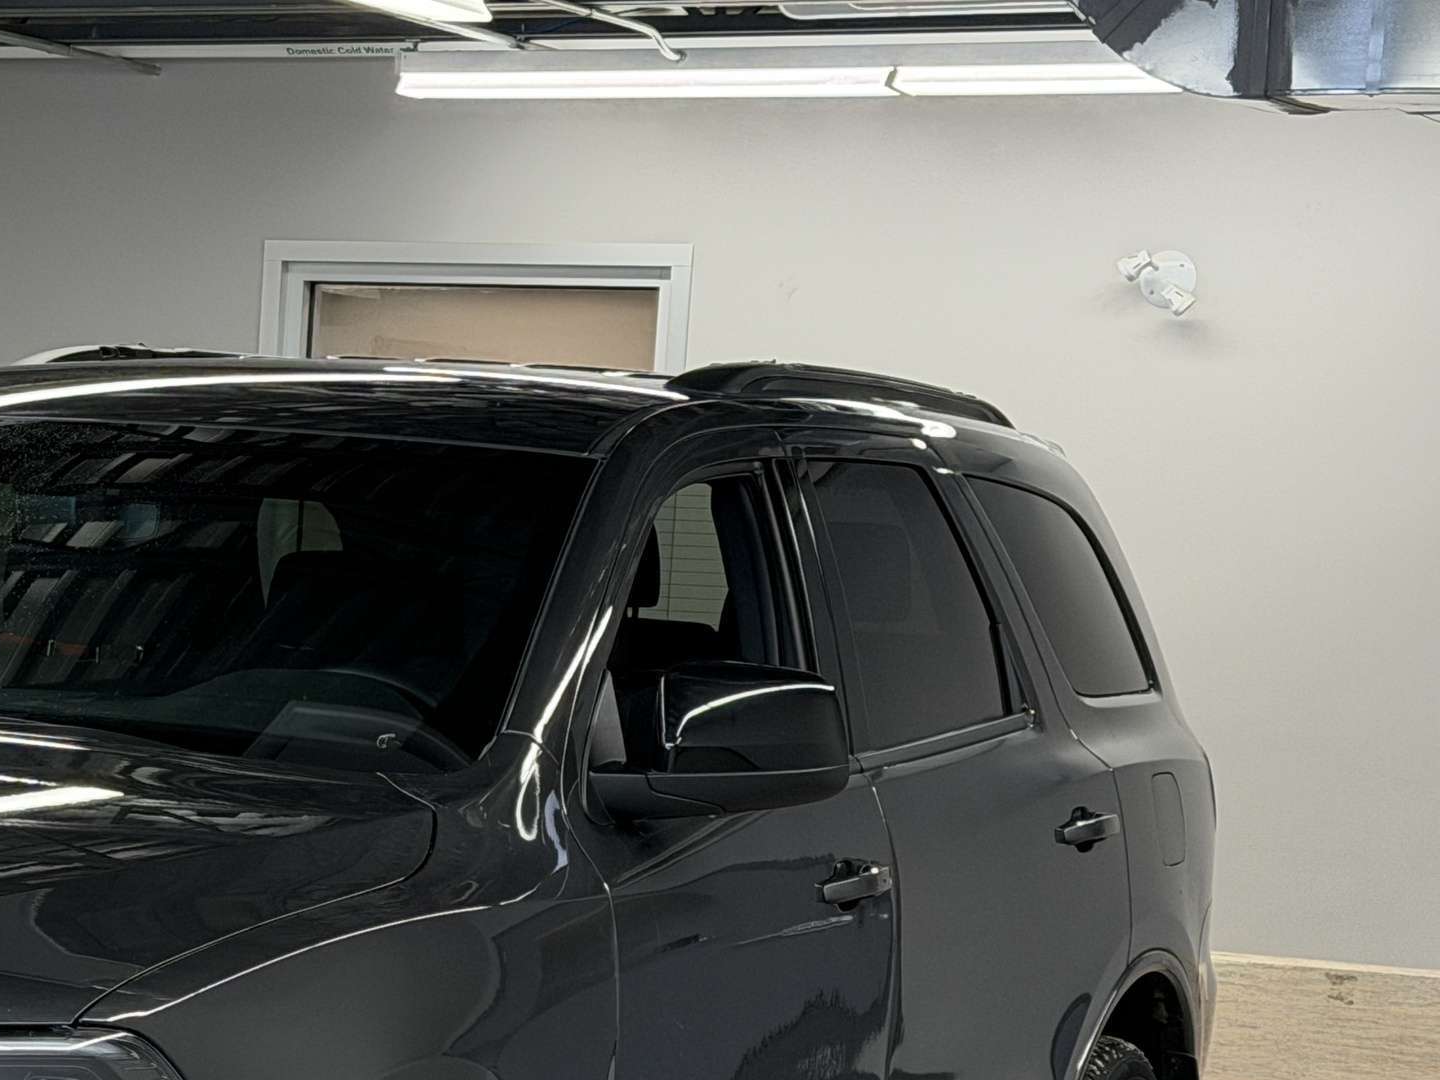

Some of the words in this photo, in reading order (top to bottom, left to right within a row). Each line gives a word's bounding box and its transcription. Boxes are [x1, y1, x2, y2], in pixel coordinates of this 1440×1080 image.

[286, 47, 335, 56] Domestic
[337, 46, 362, 55] Cold
[363, 46, 394, 55] Water
